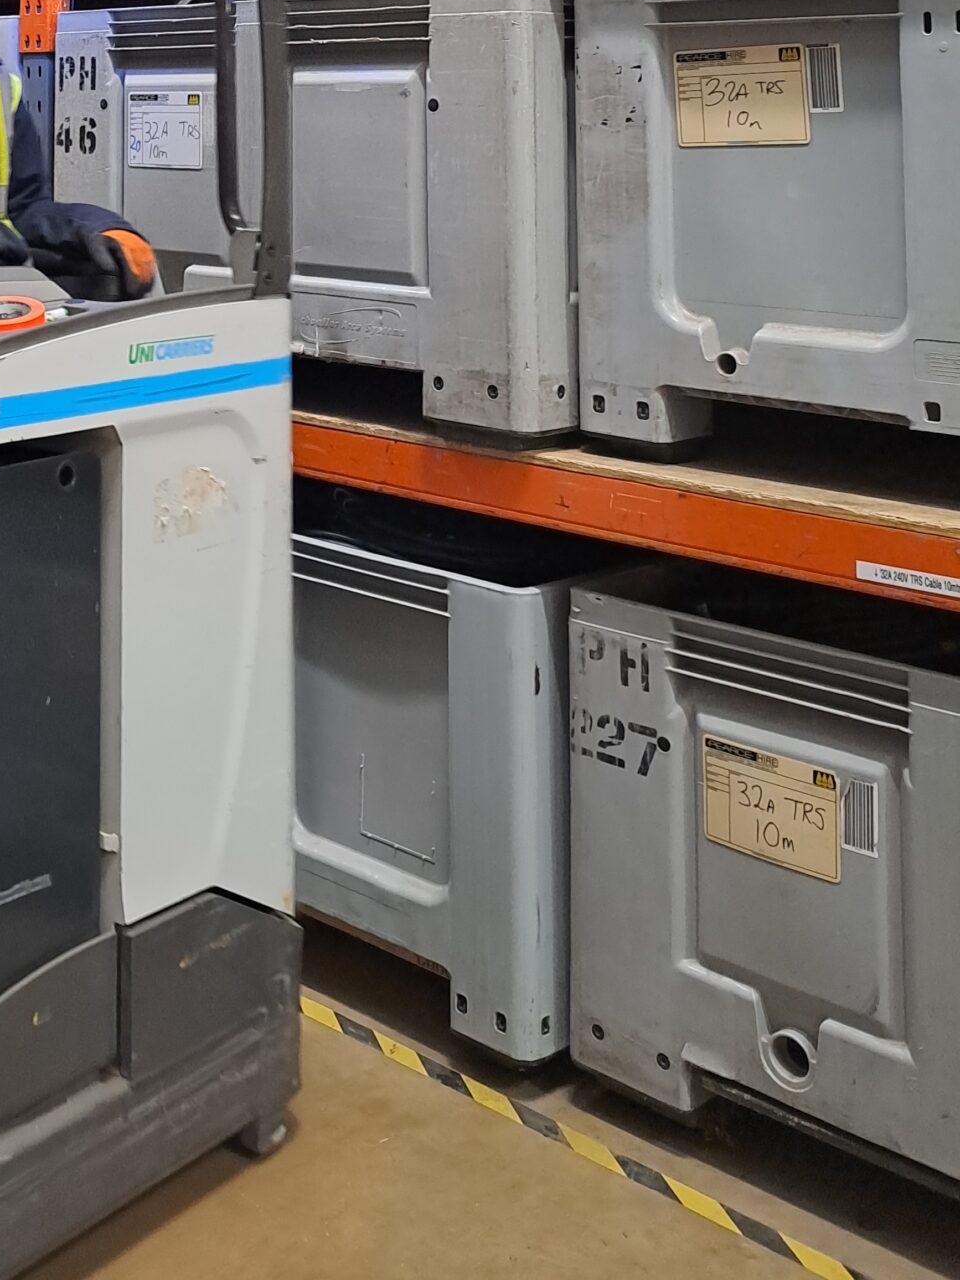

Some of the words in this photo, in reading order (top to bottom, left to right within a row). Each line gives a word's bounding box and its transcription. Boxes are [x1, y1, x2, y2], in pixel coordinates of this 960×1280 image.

[676, 51, 726, 62] PEARCE
[59, 55, 96, 92] PH
[705, 77, 748, 106] 32A
[754, 80, 786, 95] TRS
[56, 117, 97, 154] 46
[143, 121, 168, 143] 32A
[178, 120, 200, 140] TRS
[880, 568, 892, 580] 32A
[893, 571, 908, 583] 240V
[910, 574, 923, 586] TRS
[924, 577, 942, 590] Cable
[705, 737, 757, 762] PEARCE
[757, 752, 779, 769] HIRE
[737, 780, 775, 814] 32A
[784, 796, 826, 831] TRS
[756, 818, 795, 853] 10m
